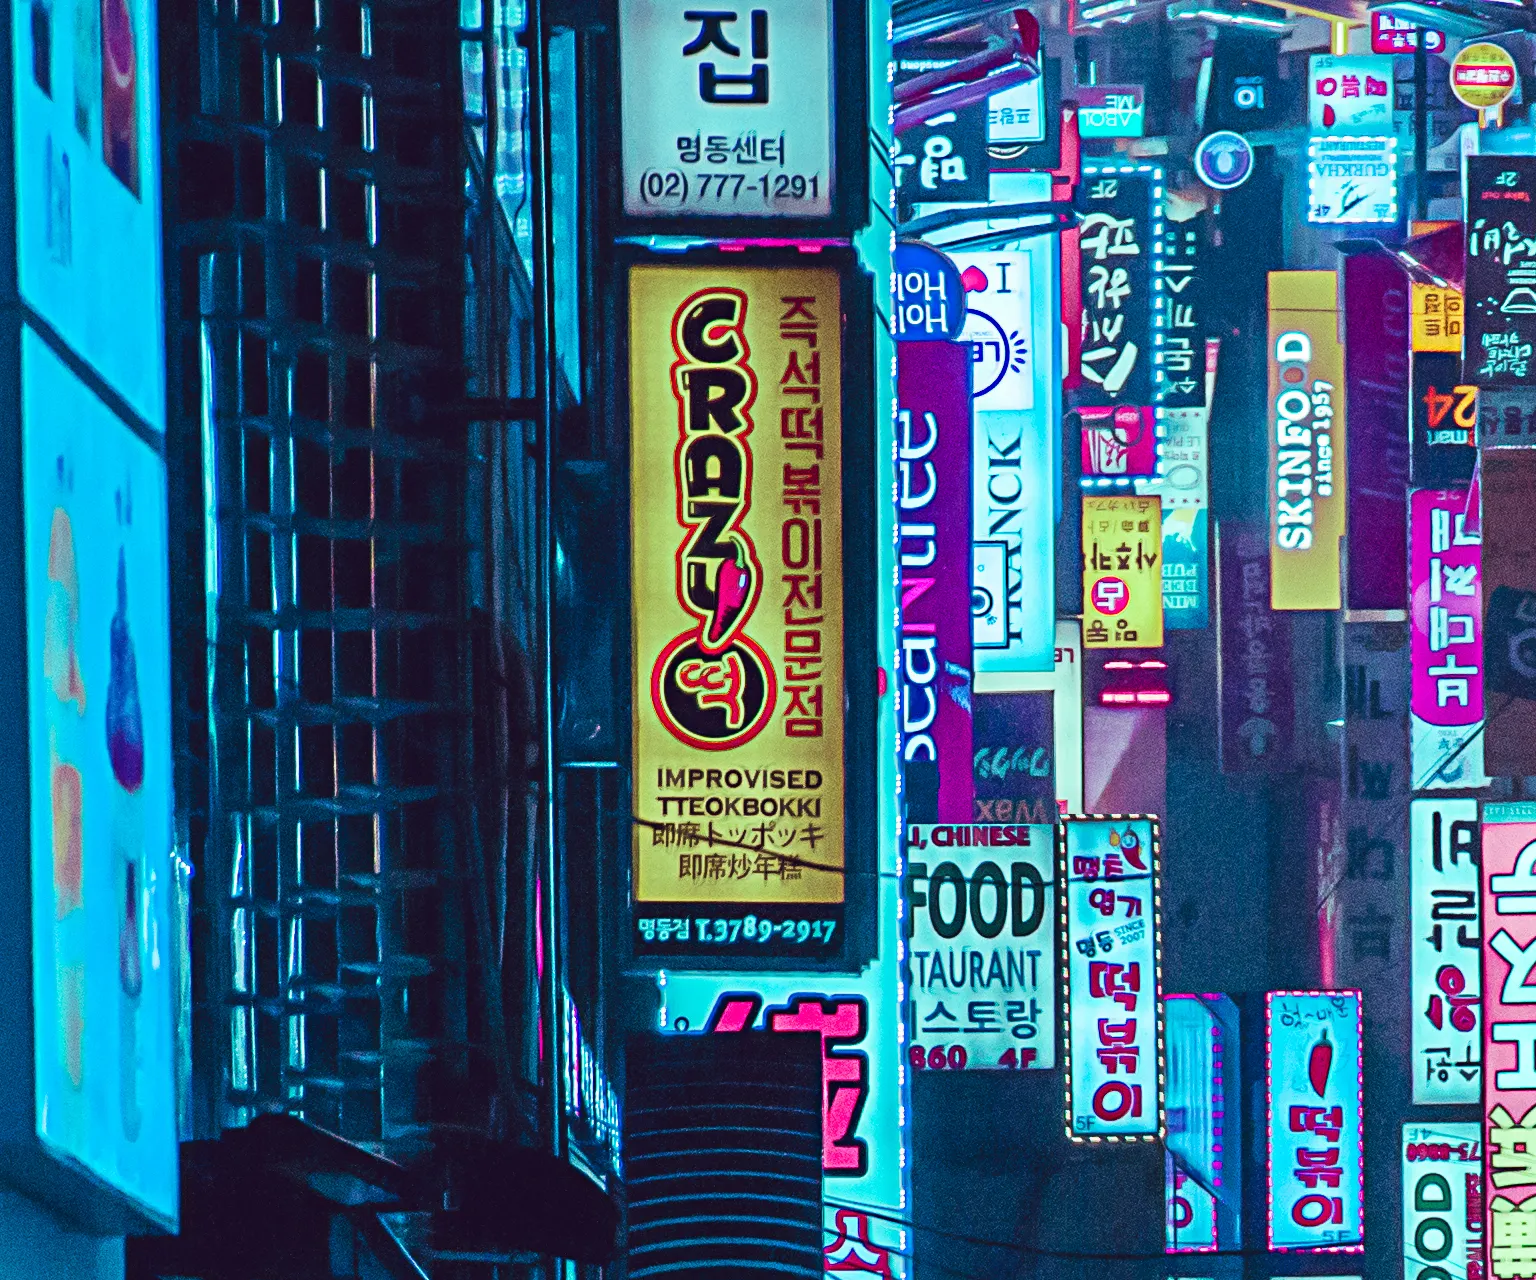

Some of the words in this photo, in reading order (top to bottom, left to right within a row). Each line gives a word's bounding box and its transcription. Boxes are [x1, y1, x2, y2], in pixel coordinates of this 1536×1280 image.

[682, 8, 770, 106] 집
[675, 132, 786, 167] 명동센터
[638, 172, 690, 203] (02)
[696, 172, 822, 203] 777-1291
[896, 302, 948, 333] Hol
[1421, 383, 1477, 428] 24
[1272, 329, 1312, 548] SKINFOOD
[671, 288, 765, 645] CRAZY
[1081, 539, 1157, 570] 사주카
[1426, 506, 1479, 707] 부대찌개
[657, 768, 824, 790] IMPROVISED
[657, 797, 822, 819] TTEOKBOKKI
[931, 826, 1031, 848] CHINESE
[906, 862, 1046, 939] FOOD
[638, 917, 690, 942] 명동점
[695, 915, 836, 945] T.3789-2917
[910, 1002, 1044, 1039] 스토랑
[998, 1046, 1038, 1070] 4F
[1088, 960, 1143, 1123] 떡볶이
[1075, 1115, 1096, 1131] 5F
[1287, 1105, 1345, 1229] 떡볶이
